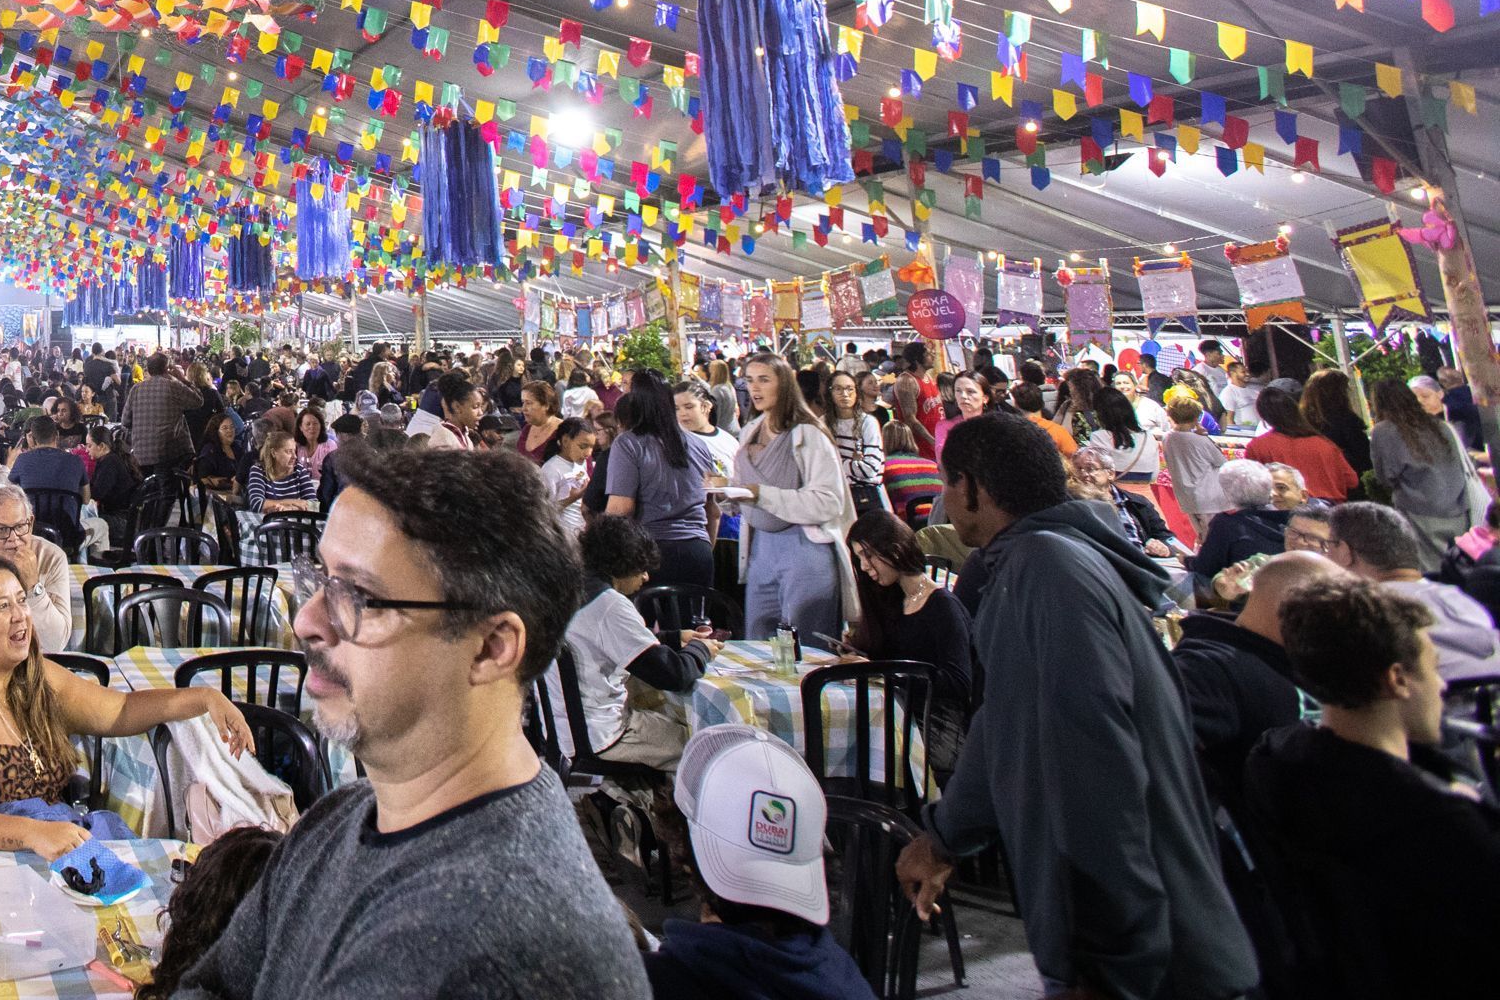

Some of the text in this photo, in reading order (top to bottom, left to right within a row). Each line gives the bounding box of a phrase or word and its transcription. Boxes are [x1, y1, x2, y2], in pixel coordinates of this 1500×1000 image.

[912, 295, 949, 308] CAIXA
[912, 306, 955, 318] MÓVEL
[756, 821, 788, 836] DUBAI
